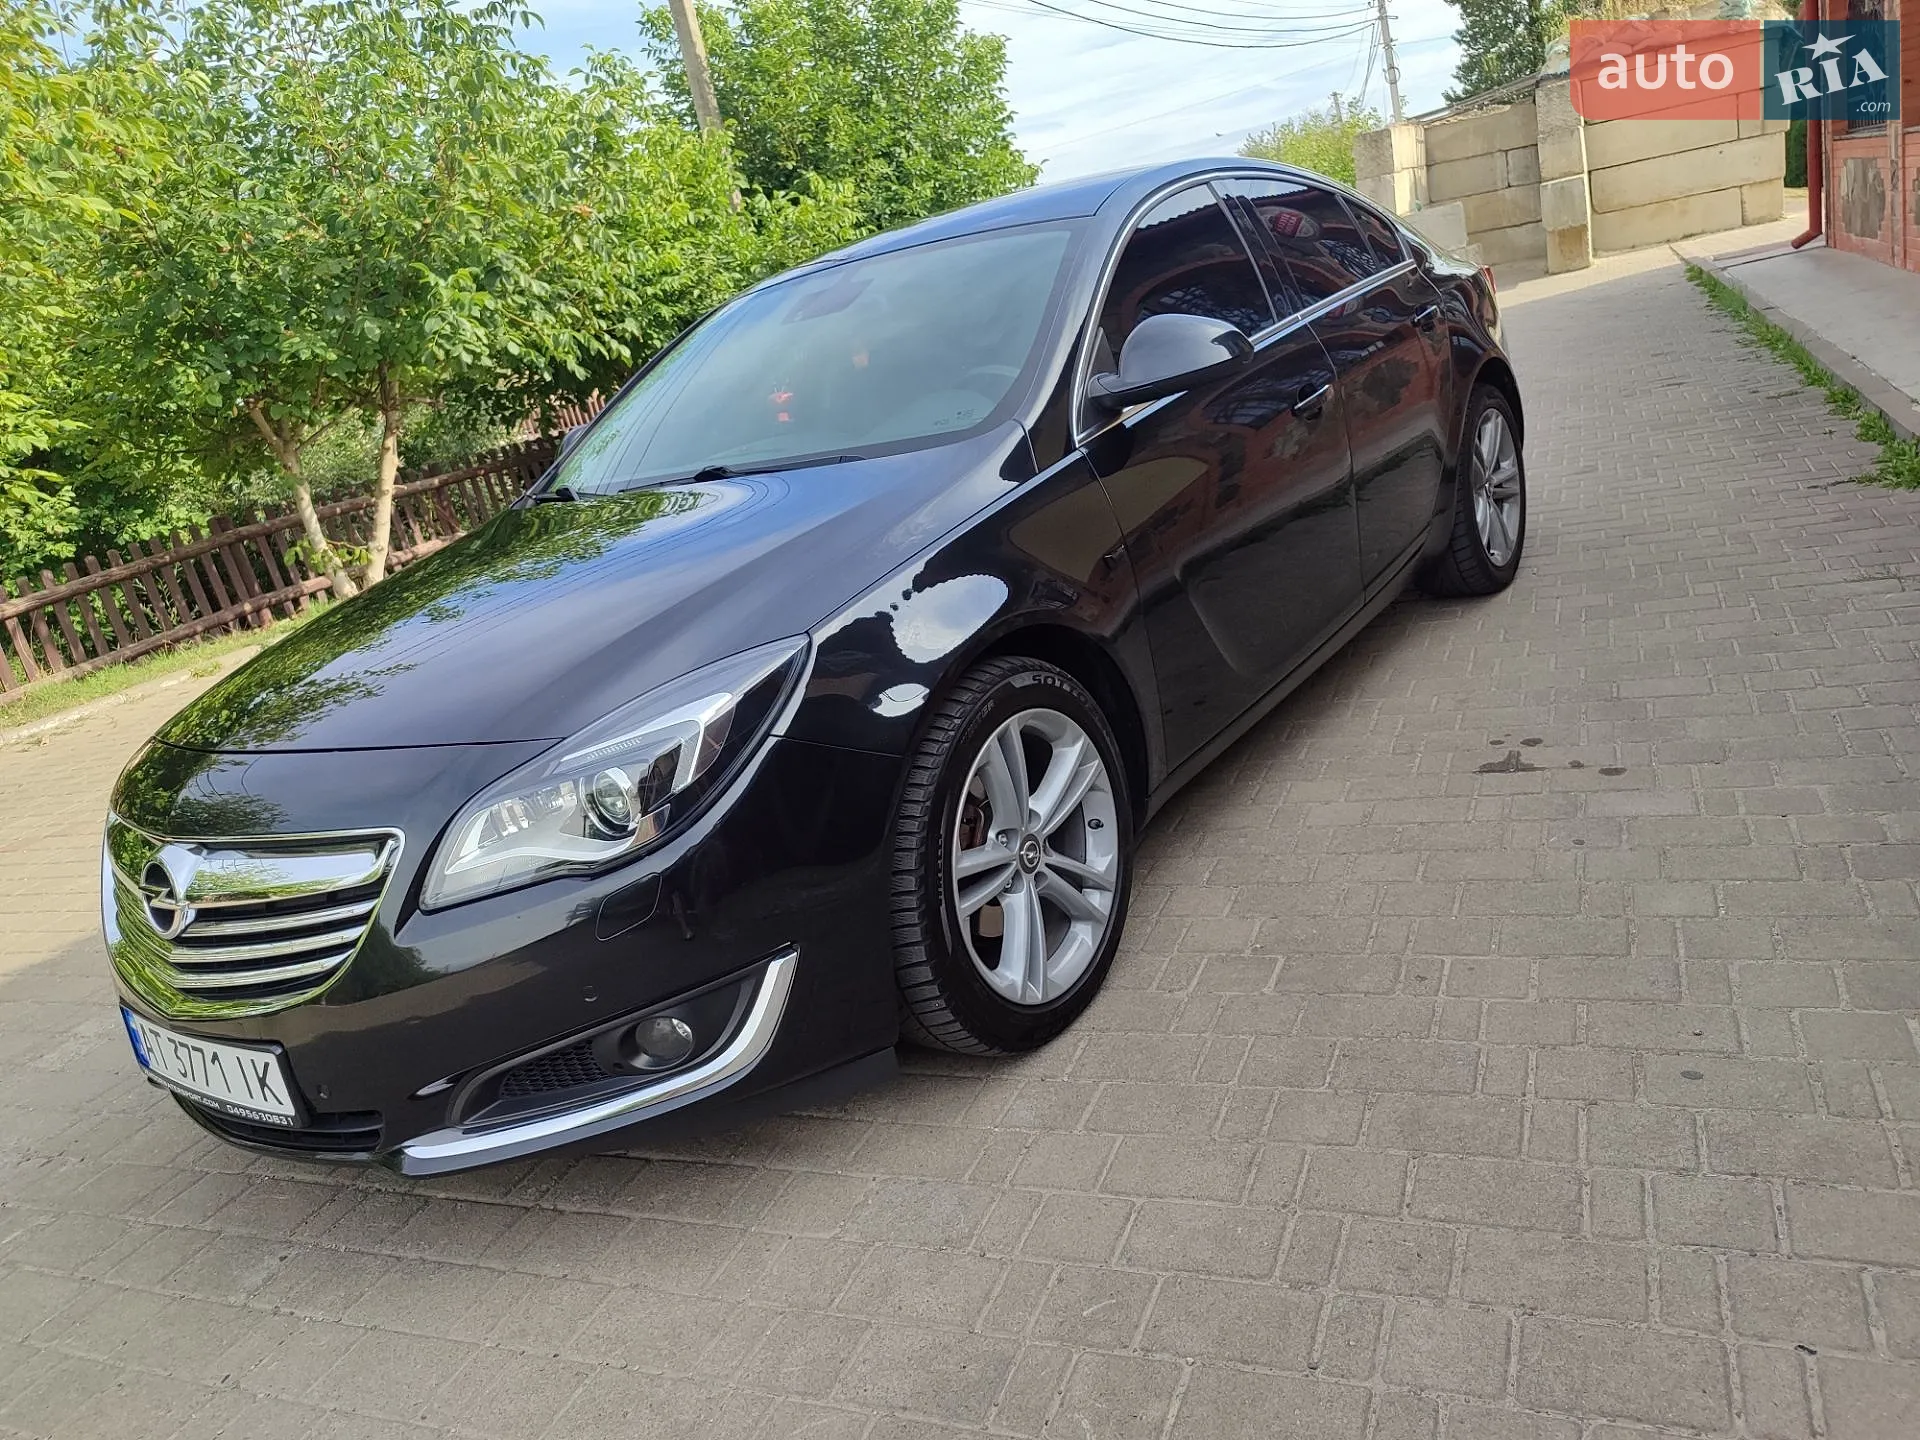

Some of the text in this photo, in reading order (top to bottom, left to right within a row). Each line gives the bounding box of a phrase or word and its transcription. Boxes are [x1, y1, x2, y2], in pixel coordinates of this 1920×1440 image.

[140, 1023, 285, 1106] AT 3771 IK
